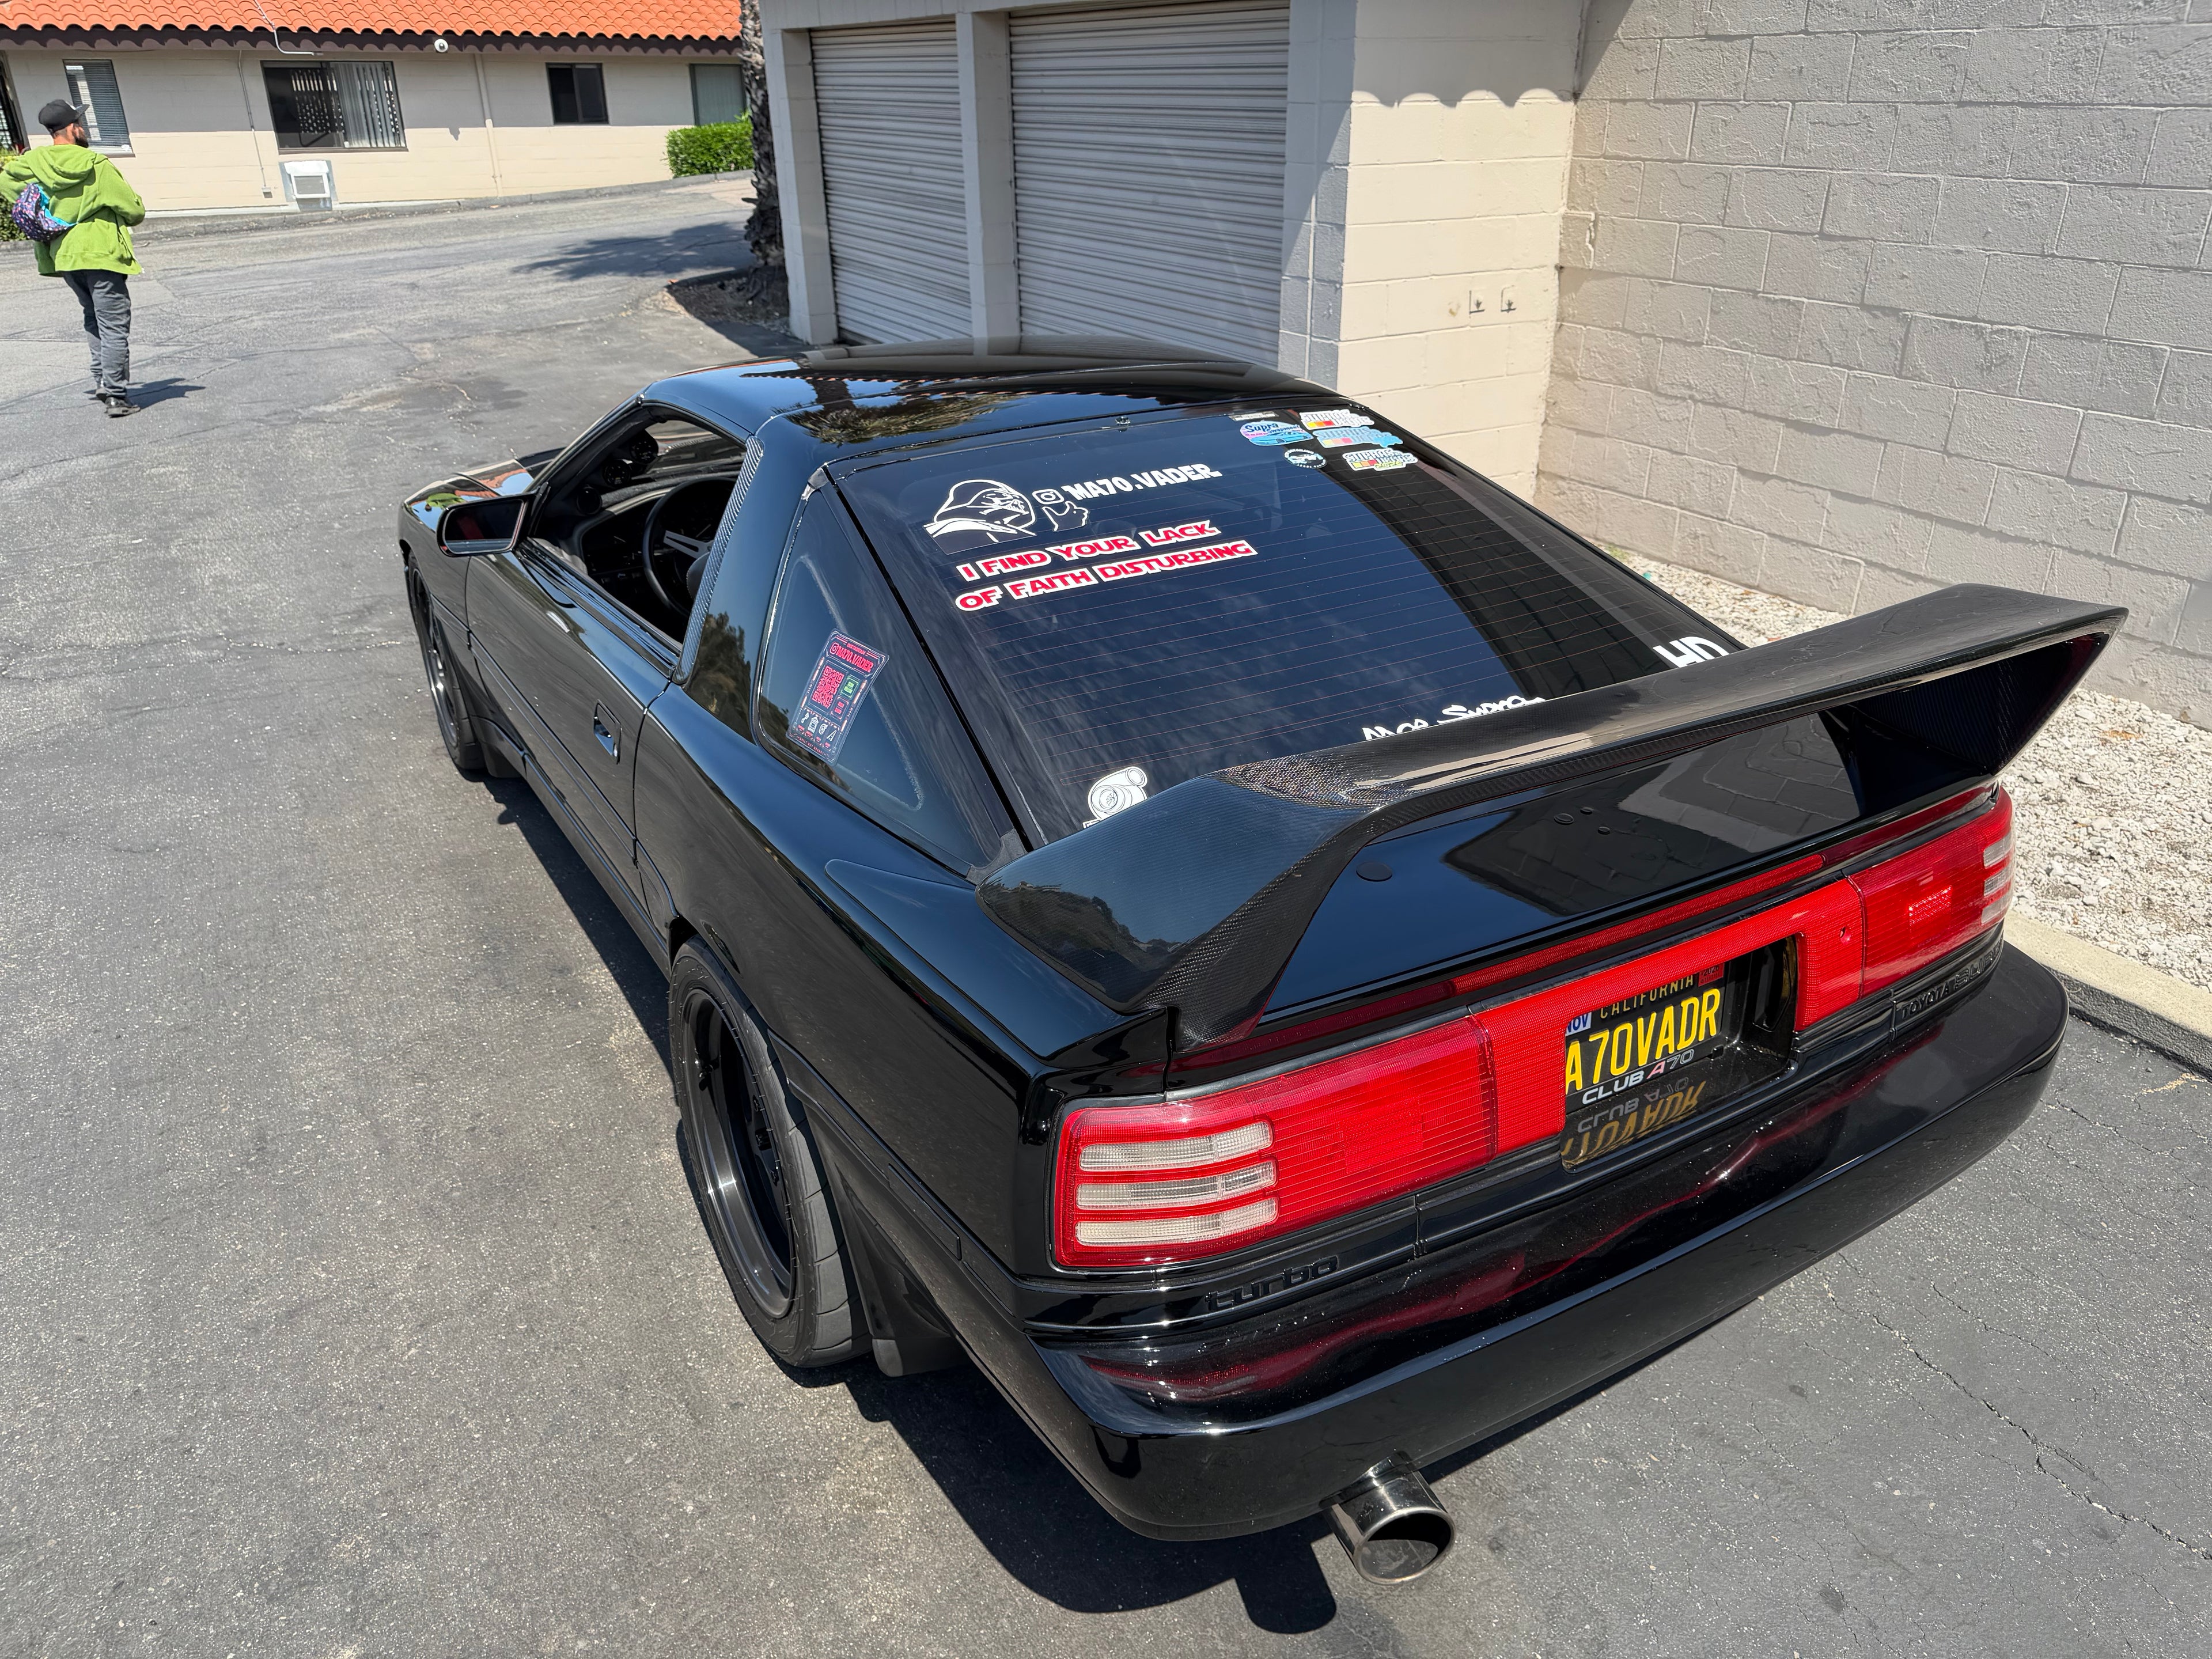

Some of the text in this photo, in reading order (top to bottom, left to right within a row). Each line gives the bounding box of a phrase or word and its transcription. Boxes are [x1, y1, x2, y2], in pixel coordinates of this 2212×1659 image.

[1245, 423, 1279, 432] Supra
[1346, 449, 1393, 462] SUPRAS
[1061, 463, 1223, 501] MA70.VADER
[980, 551, 1049, 574] FIND
[1054, 537, 1136, 560] YOUR
[1145, 522, 1217, 544] LACK
[958, 542, 1253, 610] OF FAITH DISTURBING
[1901, 981, 1950, 1019] TOYOTA
[1582, 1048, 1695, 1105] CLUB A70
[1205, 1255, 1340, 1310] turbo
